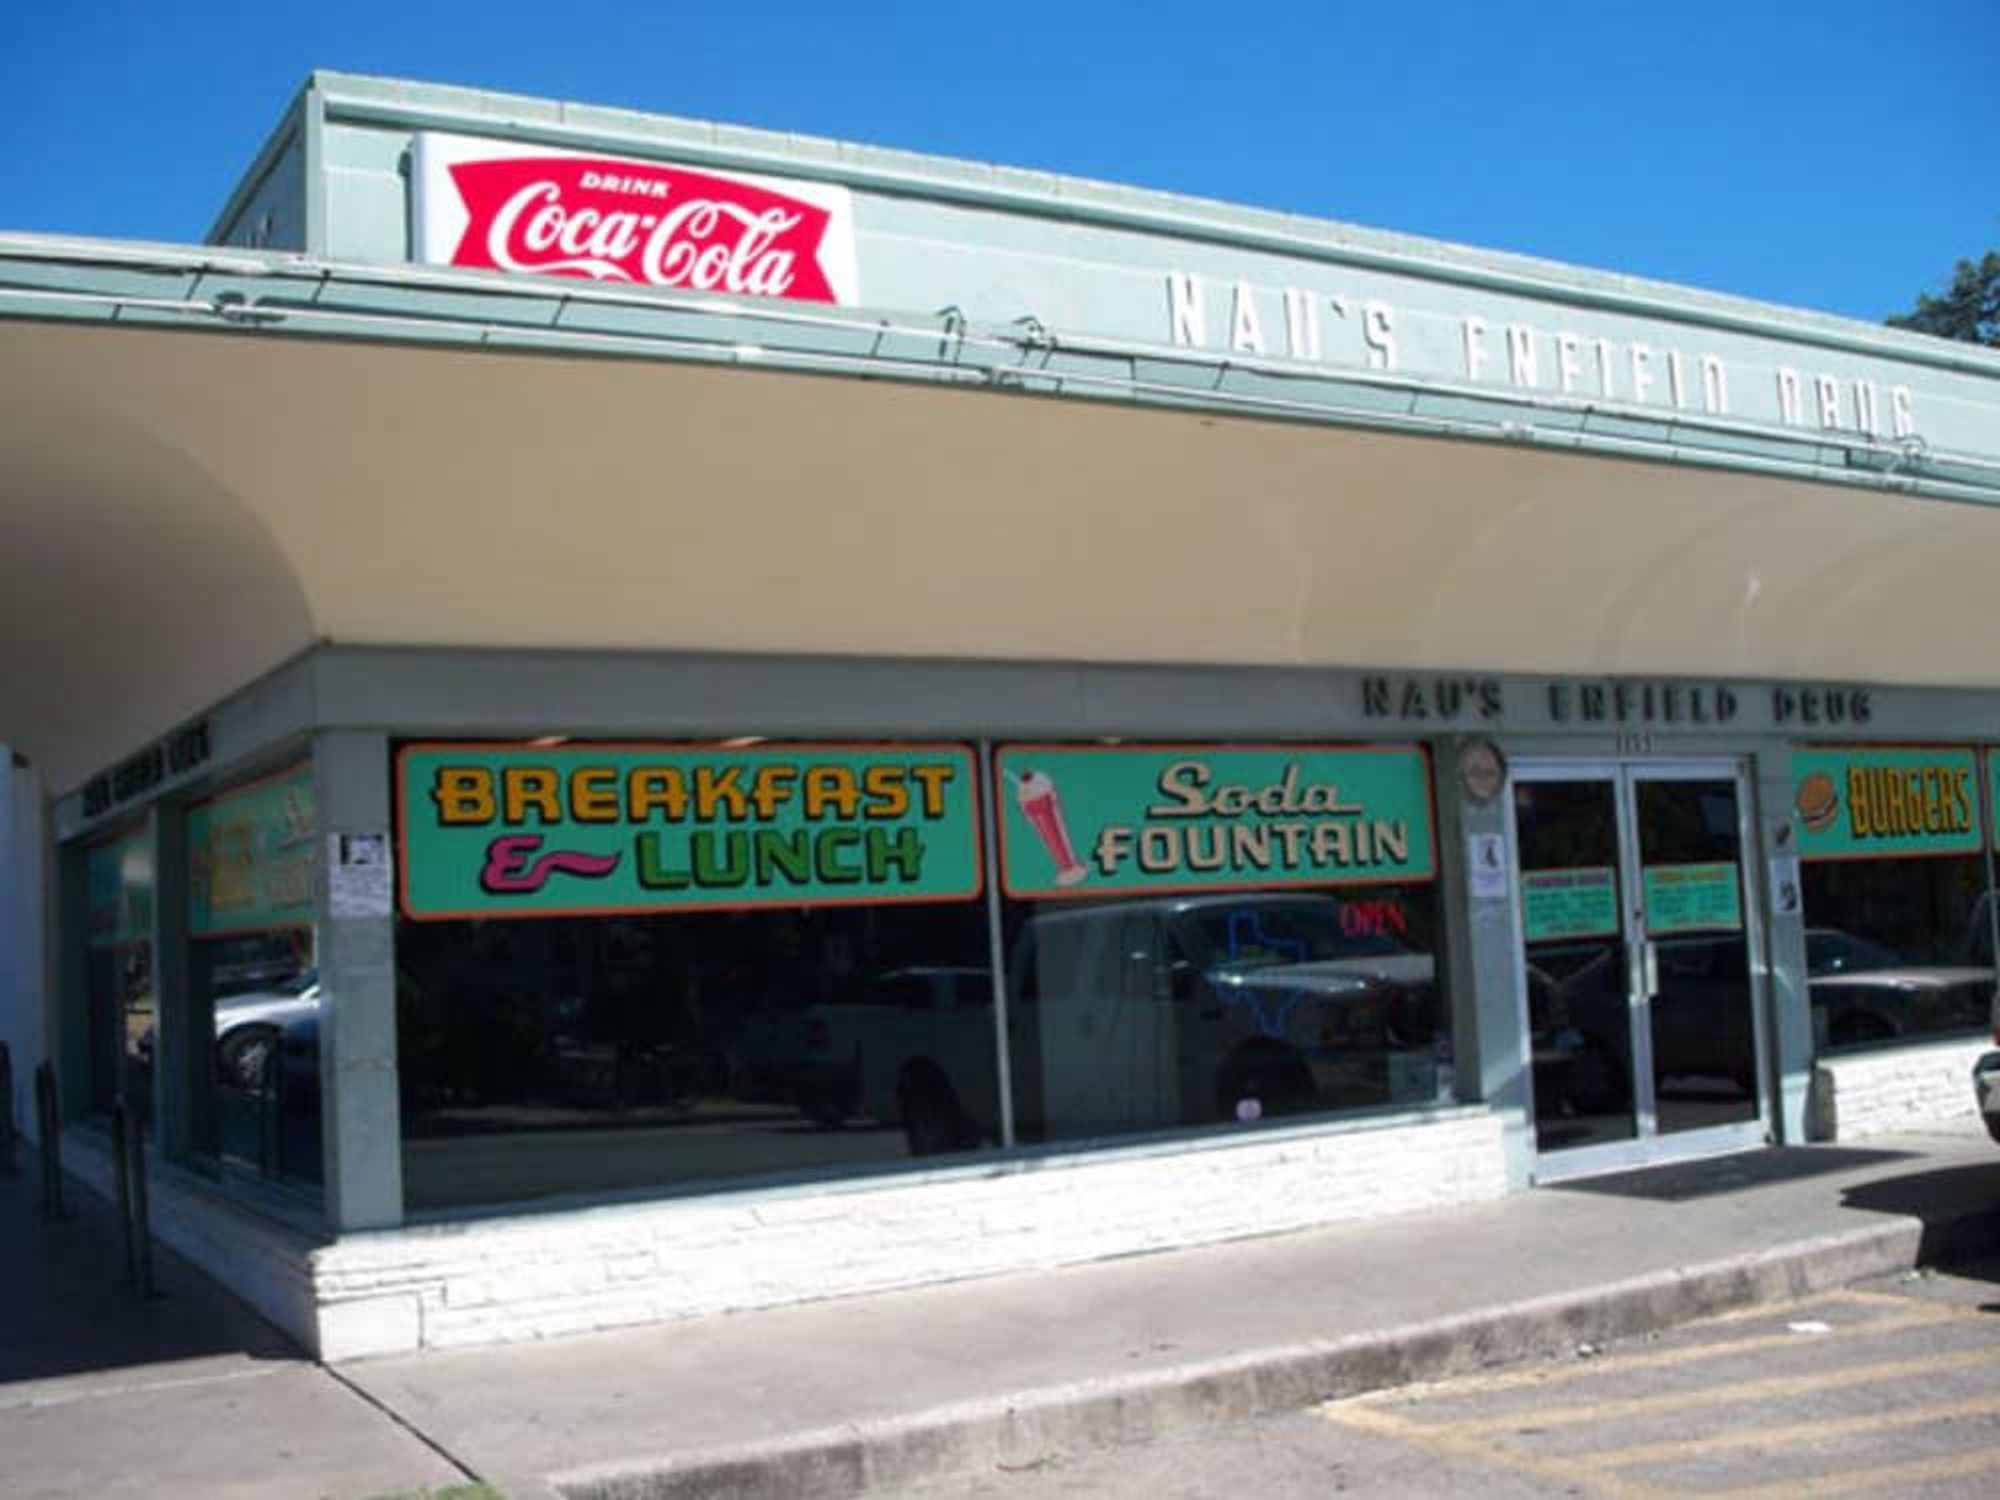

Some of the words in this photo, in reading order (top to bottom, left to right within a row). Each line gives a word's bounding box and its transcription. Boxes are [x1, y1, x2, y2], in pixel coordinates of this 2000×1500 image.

[580, 171, 671, 198] DRINK
[487, 181, 802, 297] Coca-Cola
[1166, 271, 1396, 368] NAU'S
[1360, 676, 1502, 721] NAU'S
[1546, 682, 1740, 725] ENFIELD
[1772, 687, 1873, 724] DRUG
[431, 764, 956, 824] BREAKFAST
[1146, 760, 1364, 818] Soda
[1847, 767, 1972, 840] BURGERS
[481, 833, 621, 893] &
[634, 826, 925, 890] LUNCH
[1093, 820, 1408, 874] FOUNTAIN
[1338, 901, 1408, 937] OPEN
